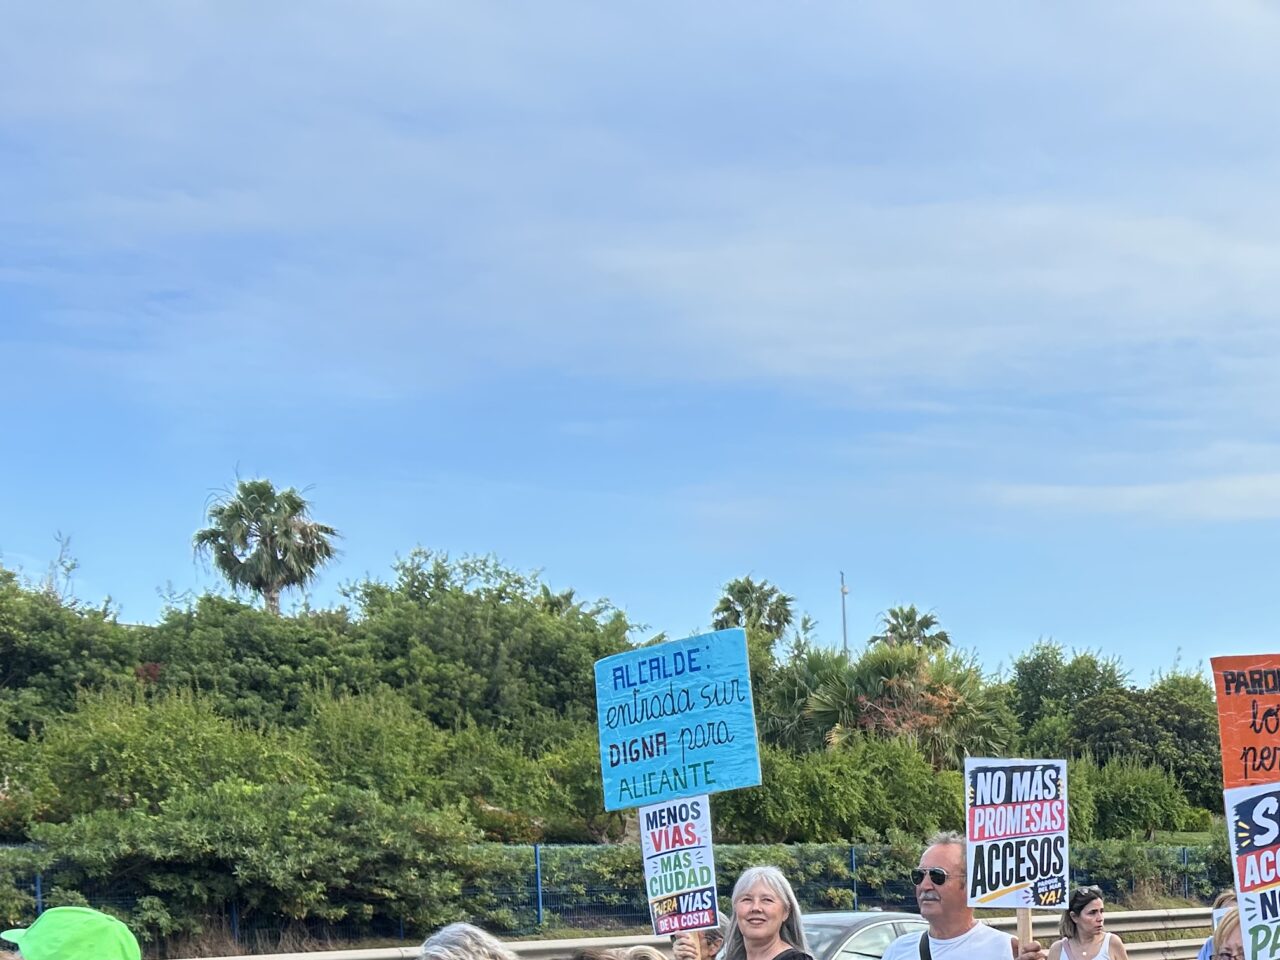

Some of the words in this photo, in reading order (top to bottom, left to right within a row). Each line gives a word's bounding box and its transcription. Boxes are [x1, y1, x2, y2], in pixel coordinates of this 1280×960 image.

[613, 645, 711, 691] ALCALDE:
[605, 680, 696, 730] entrada
[700, 677, 746, 711] sur
[1249, 699, 1280, 735] lo
[609, 731, 668, 768] DIGNA
[677, 718, 735, 763] para
[618, 760, 717, 801] ALICANTE
[976, 770, 1007, 806] NO
[1011, 765, 1058, 804] MÁS
[645, 801, 702, 831] MENOS
[973, 800, 1063, 840] PROMESAS
[650, 822, 702, 853] VÍAS,
[660, 851, 692, 874] MÁS
[970, 835, 1065, 899] ACCESOS
[649, 865, 712, 898] CIUDAD
[1039, 889, 1062, 906] YA!
[654, 896, 678, 919] FUERA
[679, 890, 712, 914] VÍAS
[659, 918, 670, 932] DE
[669, 916, 680, 930] LA
[681, 911, 711, 928] COSTA
